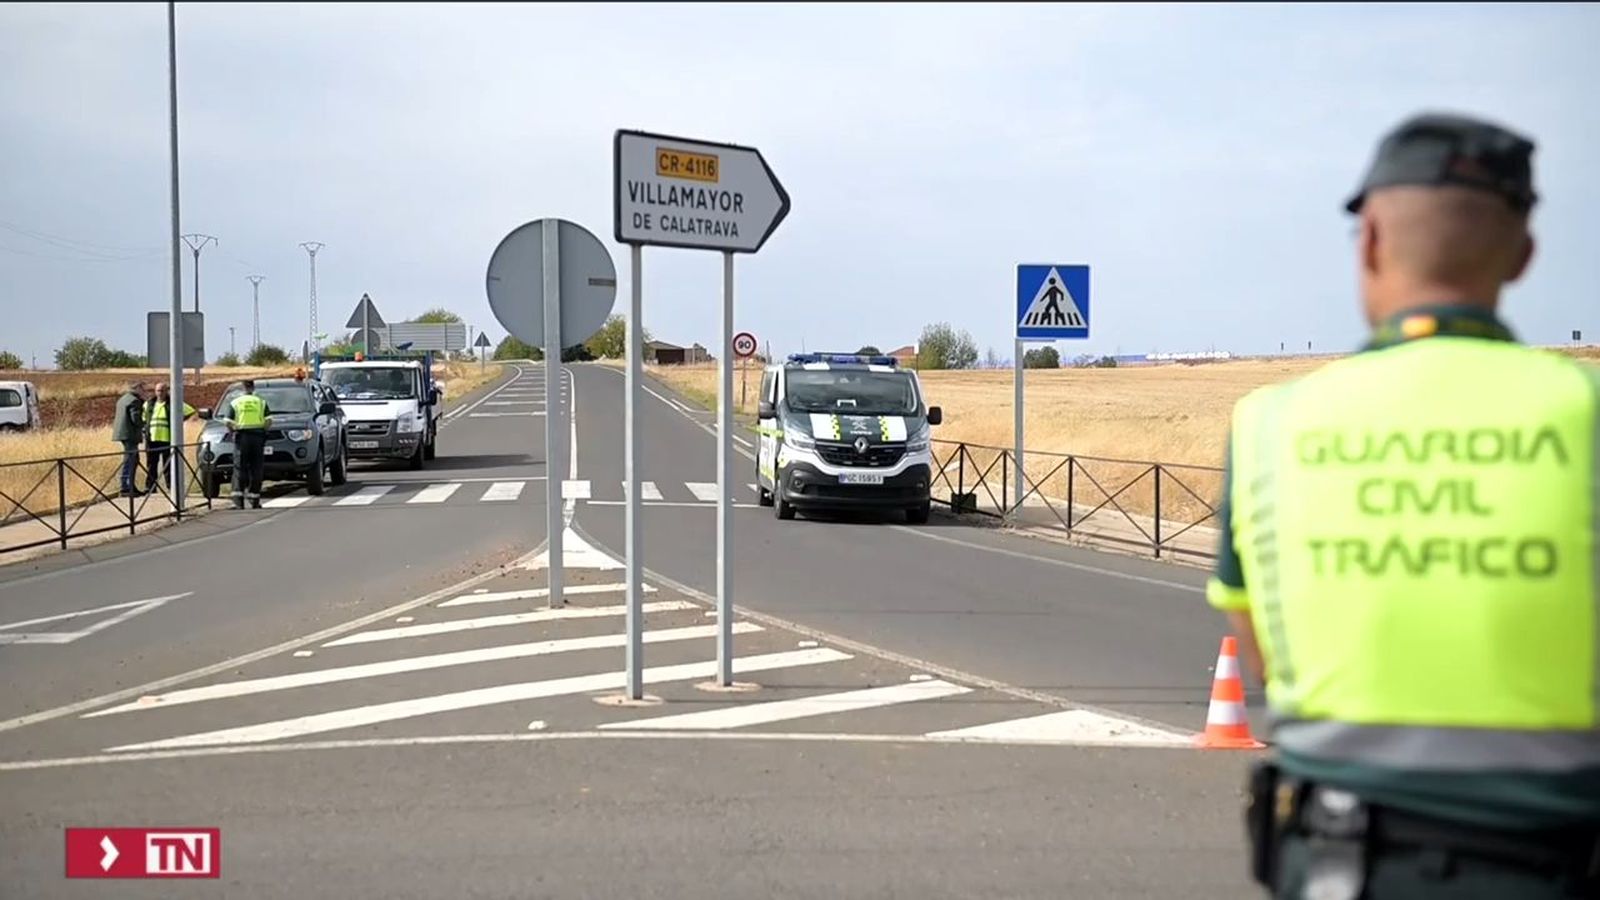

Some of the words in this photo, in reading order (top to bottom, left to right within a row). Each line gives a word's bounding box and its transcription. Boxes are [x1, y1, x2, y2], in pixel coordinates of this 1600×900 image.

[659, 152, 716, 177] CR-4116
[628, 180, 744, 213] VILLAMAYOR
[633, 212, 652, 230] DE
[660, 215, 739, 238] CALATRAVA
[738, 340, 751, 349] 90
[1298, 426, 1569, 464] GUARDIA
[1357, 478, 1493, 515] CIVIL
